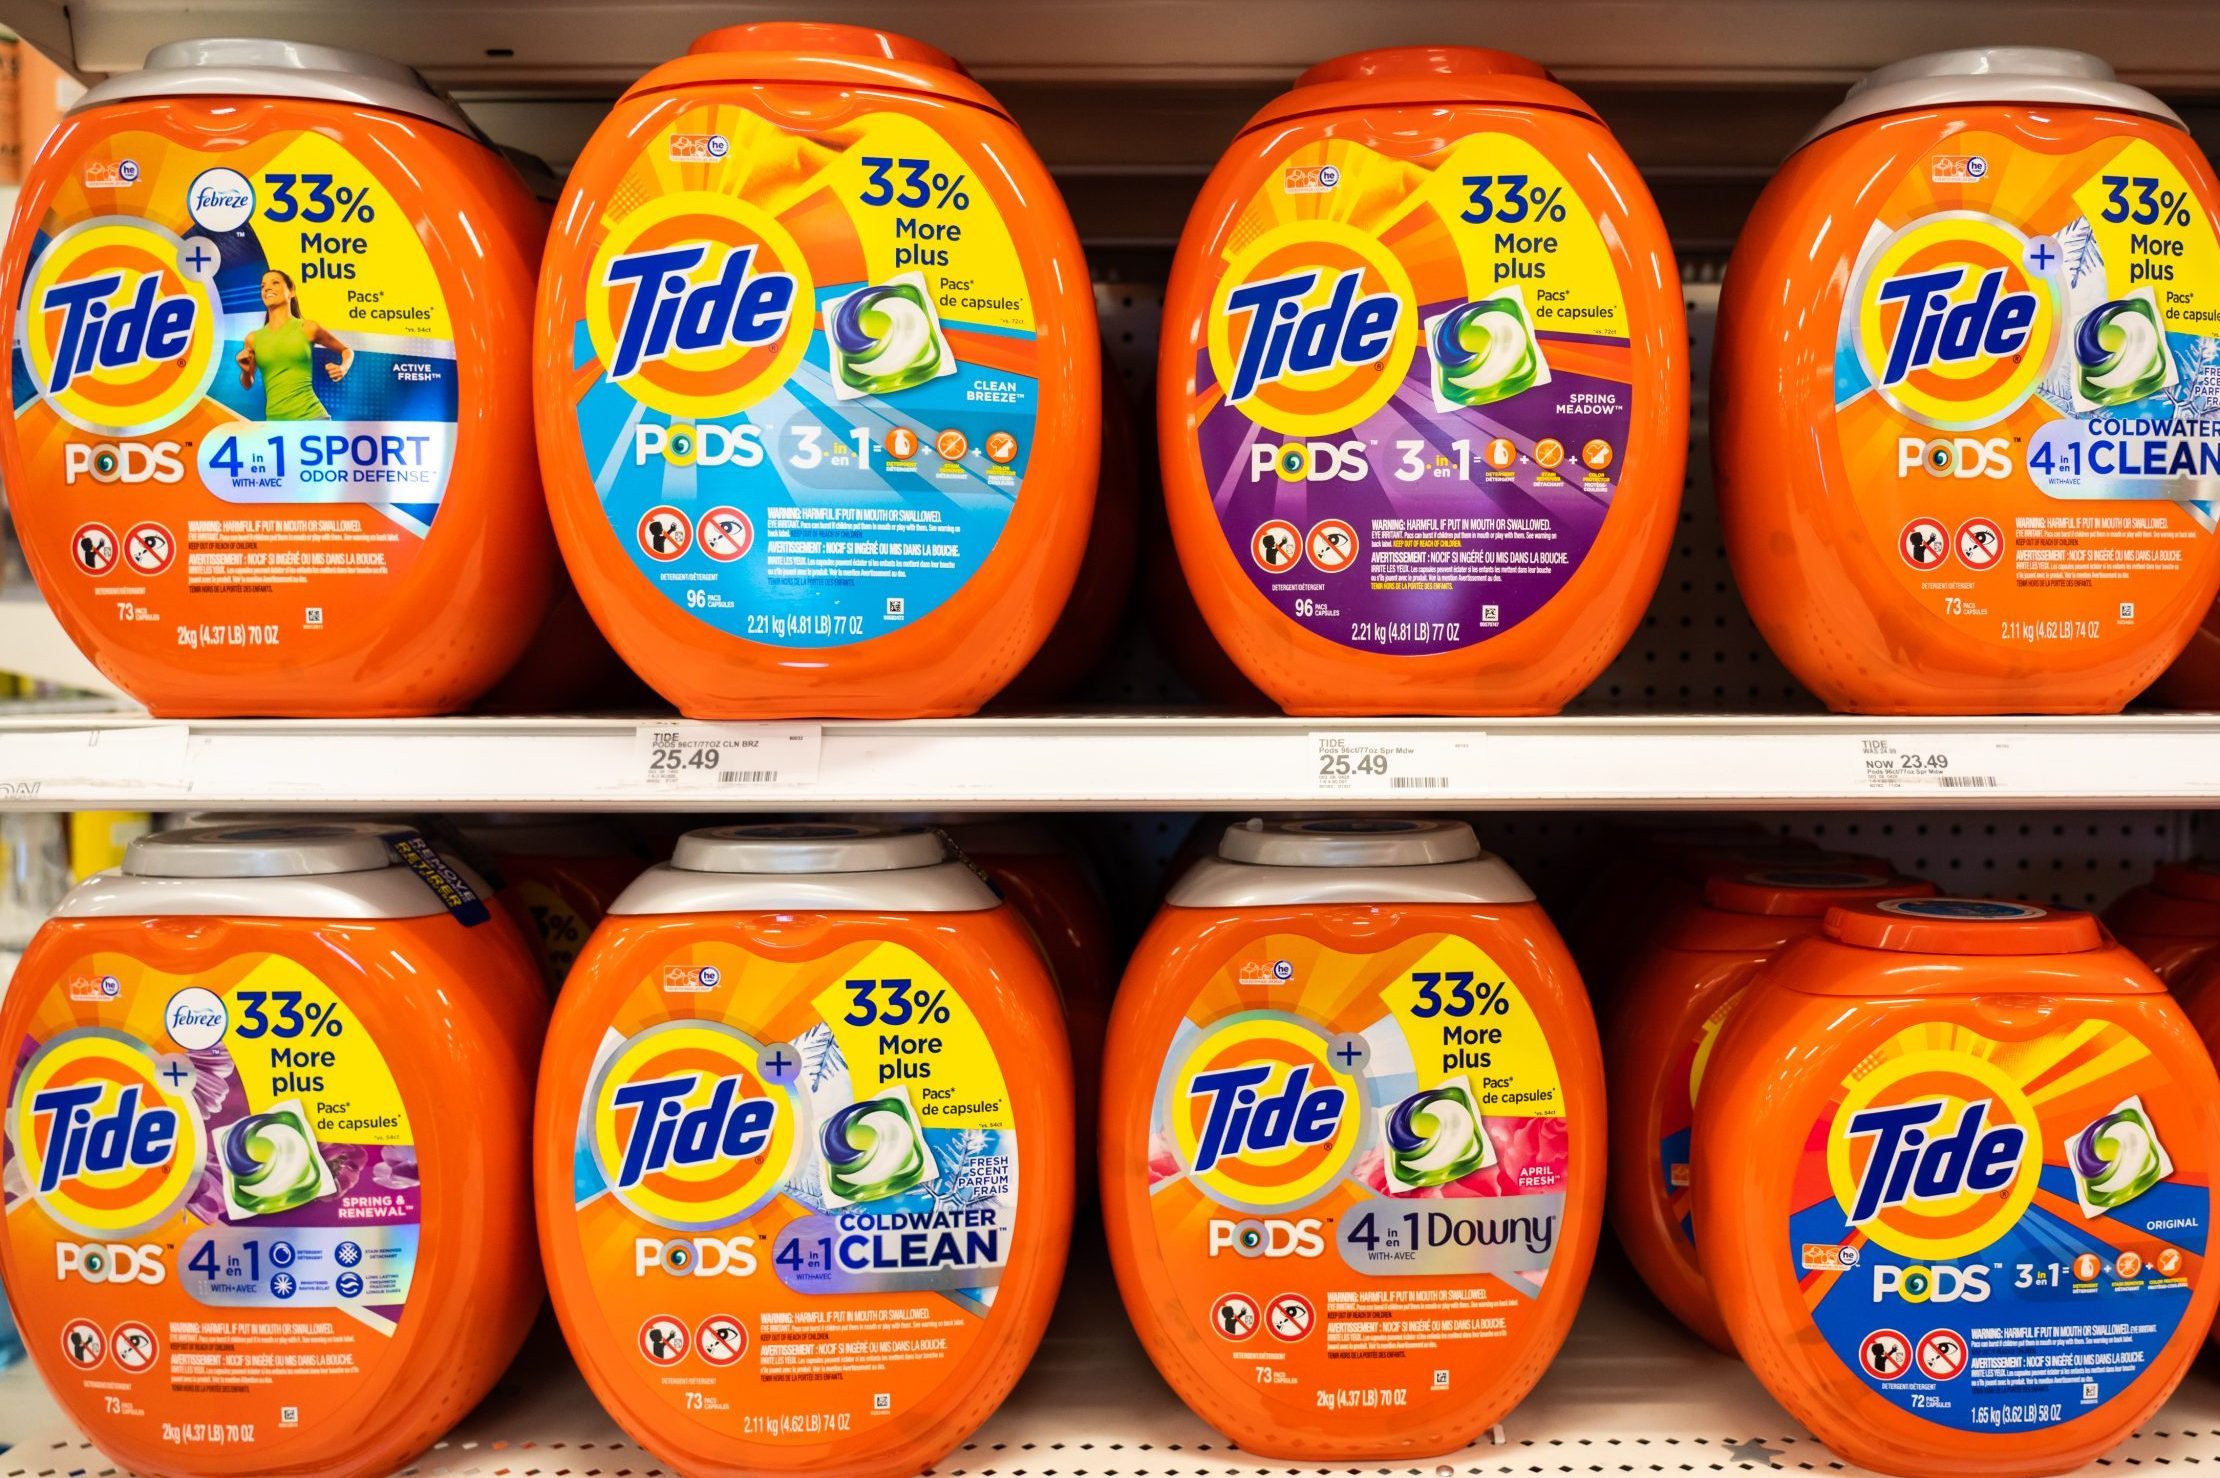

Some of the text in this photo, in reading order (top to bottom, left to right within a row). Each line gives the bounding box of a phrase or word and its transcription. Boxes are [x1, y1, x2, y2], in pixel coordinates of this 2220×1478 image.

[859, 156, 970, 212] 33%
[196, 185, 249, 211] febreze
[263, 173, 375, 224] 33%
[1460, 175, 1566, 224] 33%
[2100, 175, 2191, 227] 33%
[895, 218, 961, 241] More
[301, 233, 368, 255] More
[1494, 233, 1558, 254] More
[2130, 234, 2184, 256] More
[895, 243, 949, 268] plus
[301, 258, 356, 283] plus
[1494, 258, 1546, 282] plus
[2130, 260, 2174, 283] plus
[940, 294, 957, 308] de
[1536, 305, 1554, 318] de
[349, 306, 367, 319] de
[606, 243, 798, 383] Tide
[42, 269, 196, 396] Tide
[1224, 267, 1400, 406] Tide
[1878, 266, 2037, 390] Tide
[393, 363, 432, 373] ACTIVE
[973, 380, 1017, 392] CLEAN
[1569, 394, 1616, 404] SPRING
[2088, 418, 2220, 437] COLDWATER
[300, 435, 430, 466] SPORT
[789, 425, 822, 470] 3
[850, 427, 870, 470] 1
[2088, 440, 2220, 476] CLEAN
[300, 470, 349, 483] ODOR
[1407, 519, 1438, 530] HARMFUL
[1440, 519, 1446, 530] IF
[1448, 519, 1461, 530] PUT
[1462, 519, 1469, 530] IN
[1470, 519, 1494, 530] MOUTH
[1496, 519, 1505, 530] OR
[1431, 552, 1450, 563] NOCIF
[1452, 552, 1458, 563] SI
[1485, 552, 1495, 563] OU
[1496, 552, 1508, 563] MIS
[1510, 552, 1528, 564] DANS
[1530, 552, 1539, 564] LA
[1540, 552, 1569, 564] BOUCHE.
[687, 590, 706, 608] 96
[1295, 599, 1313, 617] 96
[1945, 598, 1962, 614] 73
[117, 602, 134, 621] 73
[177, 625, 279, 648] 2kg (4.37 LB) 70 OZ
[748, 615, 863, 638] 2.21 kg (4.81 LB) 77 OZ
[1352, 623, 1460, 644] 2.21 kg (4.81 LB) 77 OZ
[2002, 621, 2100, 642] 2.11 kg (4.62 LB) 74 OZ
[653, 733, 679, 742] TIDE
[1319, 739, 1345, 747] TIDE
[1861, 740, 1888, 748] TIDE
[650, 749, 719, 769] 25.49
[1320, 754, 1388, 775] 25.49
[1900, 754, 1948, 768] 23.49
[394, 842, 462, 907] RETIRER
[409, 838, 477, 903] REMOVE
[844, 979, 950, 1027] 33%
[1410, 971, 1510, 1019] 33%
[172, 1007, 222, 1030] febreze
[235, 991, 343, 1039] 33%
[880, 1035, 942, 1055] More
[1443, 1026, 1502, 1046] More
[272, 1048, 335, 1069] More
[1443, 1049, 1491, 1074] plus
[879, 1059, 931, 1083] plus
[272, 1072, 324, 1096] plus
[1482, 1091, 1499, 1104] de
[922, 1103, 940, 1115] de
[1188, 1063, 1345, 1176] Tide
[317, 1117, 335, 1130] de
[611, 1072, 776, 1190] Tide
[32, 1084, 179, 1196] Tide
[970, 1156, 1009, 1167] FRESH
[970, 1166, 1008, 1176] SCENT
[1519, 1166, 1553, 1177] APRIL
[1845, 1098, 2029, 1228] Tide
[958, 1175, 1009, 1187] PARFUM
[973, 1185, 1008, 1196] FRAIS
[343, 1196, 405, 1207] SPRING &
[839, 1209, 996, 1232] COLDWATER
[1347, 1212, 1380, 1251] 4
[1403, 1212, 1418, 1251] 1
[2146, 1217, 2199, 1231] ORIGINAL
[1428, 1212, 1553, 1254] Downy
[838, 1231, 998, 1272] CLEAN
[2015, 1263, 2033, 1288] 3
[2048, 1263, 2060, 1286] 1
[1911, 1394, 1924, 1408] 72
[1971, 1404, 2061, 1427] 1.65 kg (3.62 LB) 58 OZ
